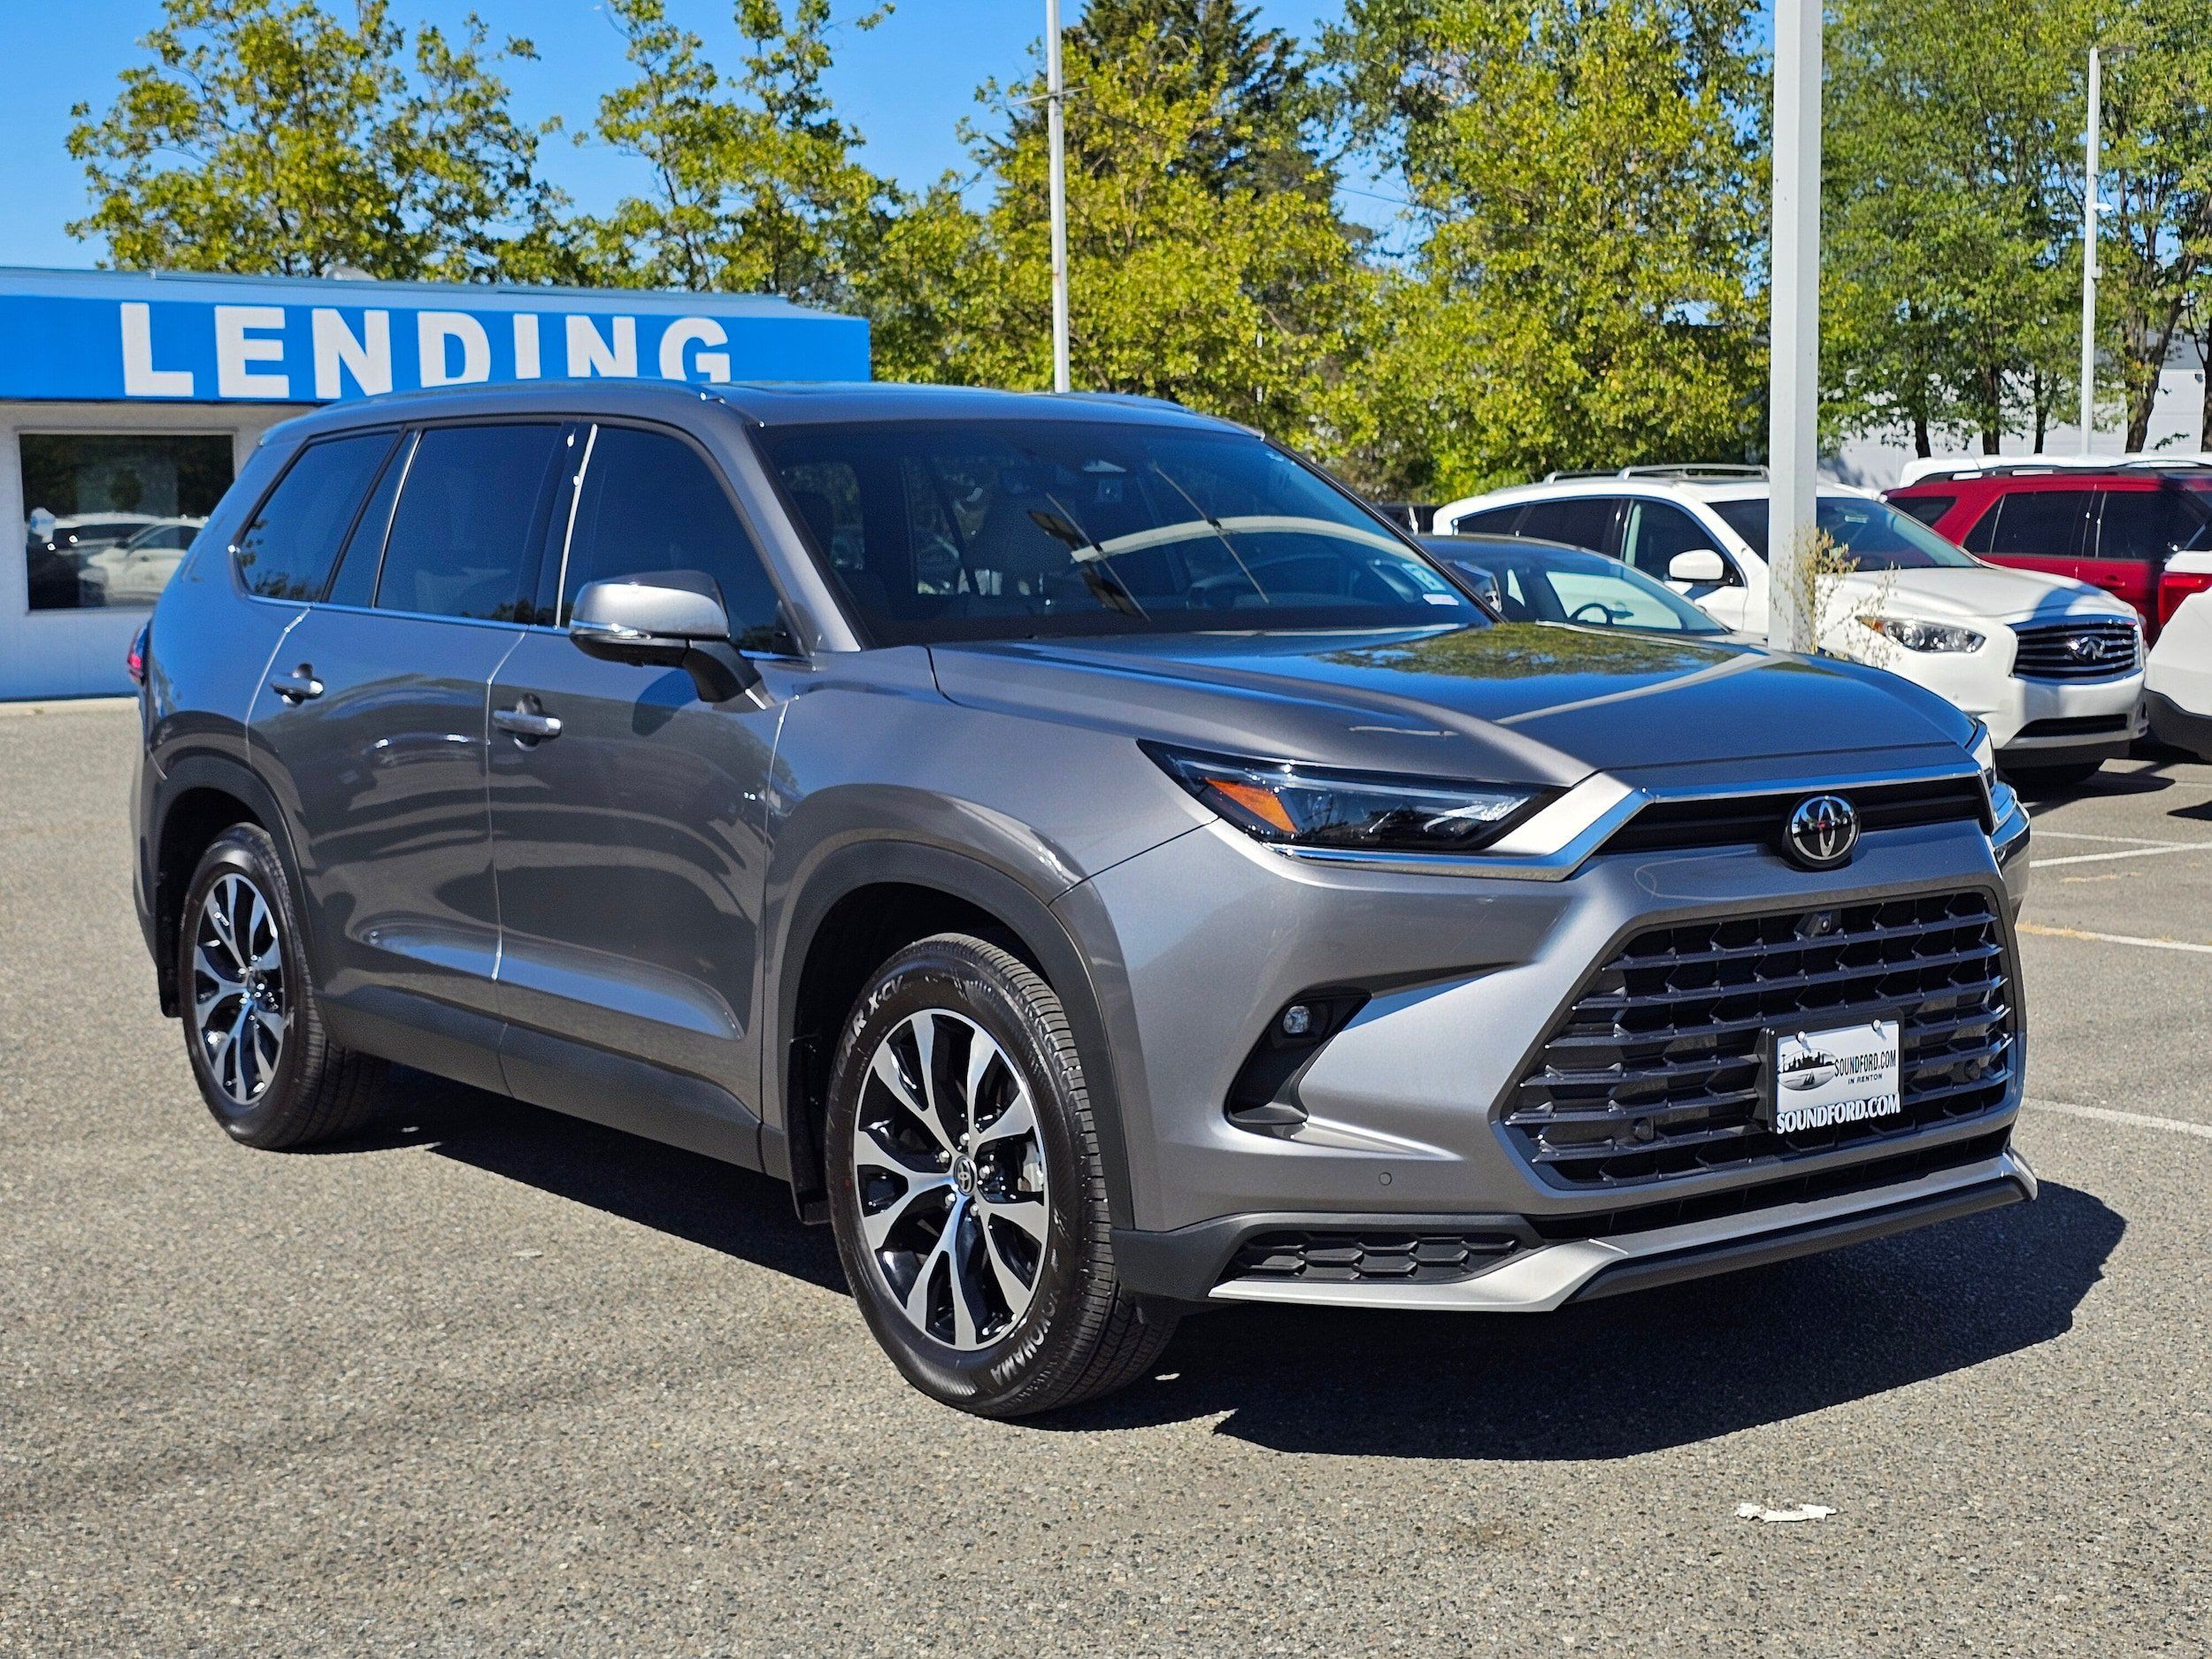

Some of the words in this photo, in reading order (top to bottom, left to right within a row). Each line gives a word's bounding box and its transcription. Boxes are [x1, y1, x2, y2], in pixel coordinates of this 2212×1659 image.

[120, 302, 731, 398] LENDING
[1834, 1048, 1897, 1078] SOUNDFORD.COM
[1856, 1073, 1883, 1084] RENTON
[1776, 1093, 1901, 1134] SOUNDFORD.COM
[989, 1289, 1061, 1386] YOKOHAMA
